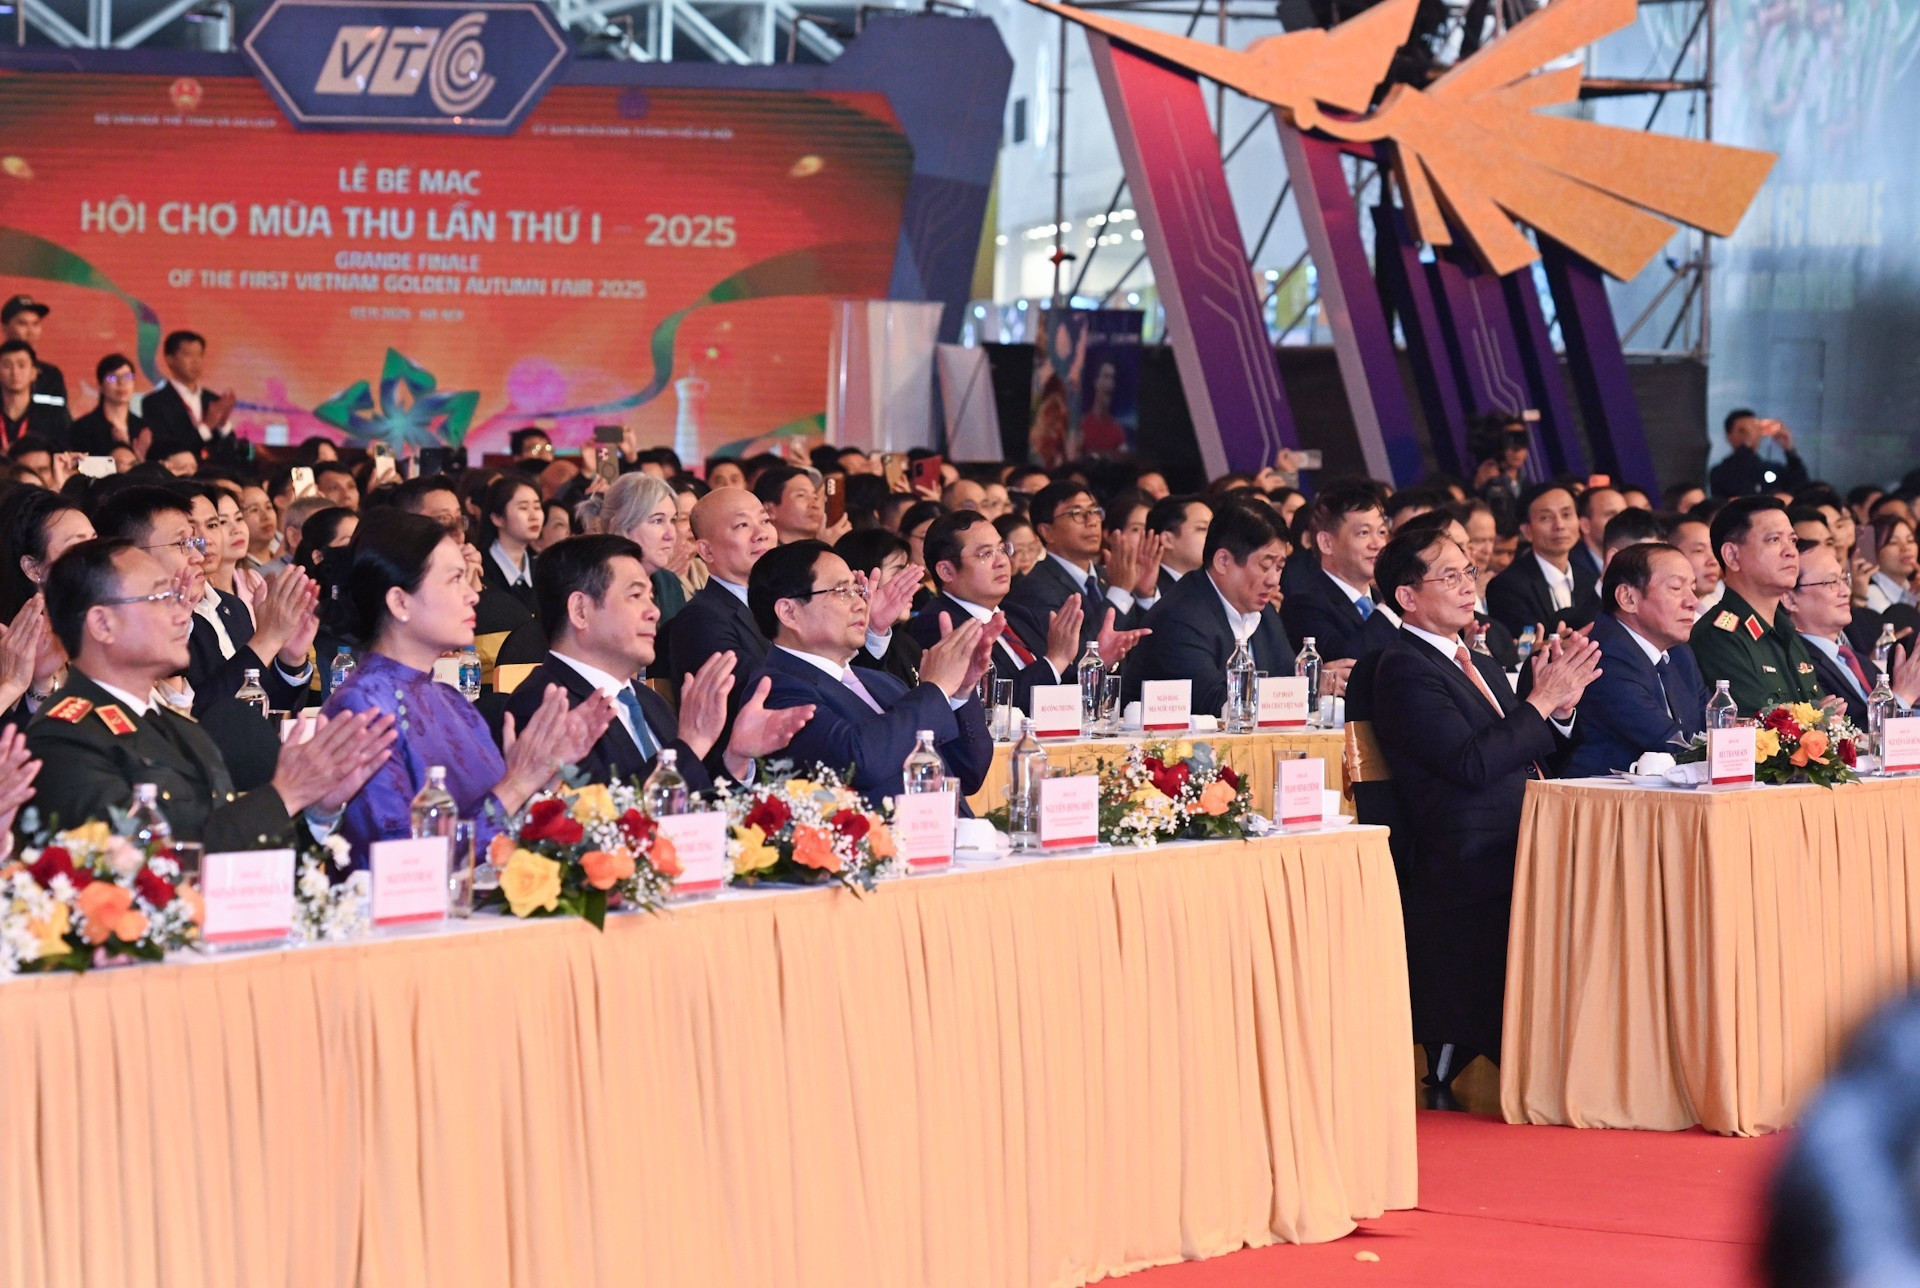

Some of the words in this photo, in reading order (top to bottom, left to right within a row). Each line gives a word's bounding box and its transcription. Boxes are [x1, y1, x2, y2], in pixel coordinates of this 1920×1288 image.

[342, 206, 416, 240] THU
[591, 212, 601, 244] I
[645, 213, 738, 248] 2025
[334, 250, 411, 270] GRANDE
[417, 253, 481, 273] FINALE
[168, 268, 194, 288] OF
[200, 269, 235, 289] THE
[239, 269, 290, 290] FIRST
[295, 271, 379, 292] VIETNAM
[383, 273, 460, 294] GOLDEN
[465, 275, 547, 296] AUTUMN
[552, 277, 594, 298] FAIR
[598, 279, 647, 299] 2025
